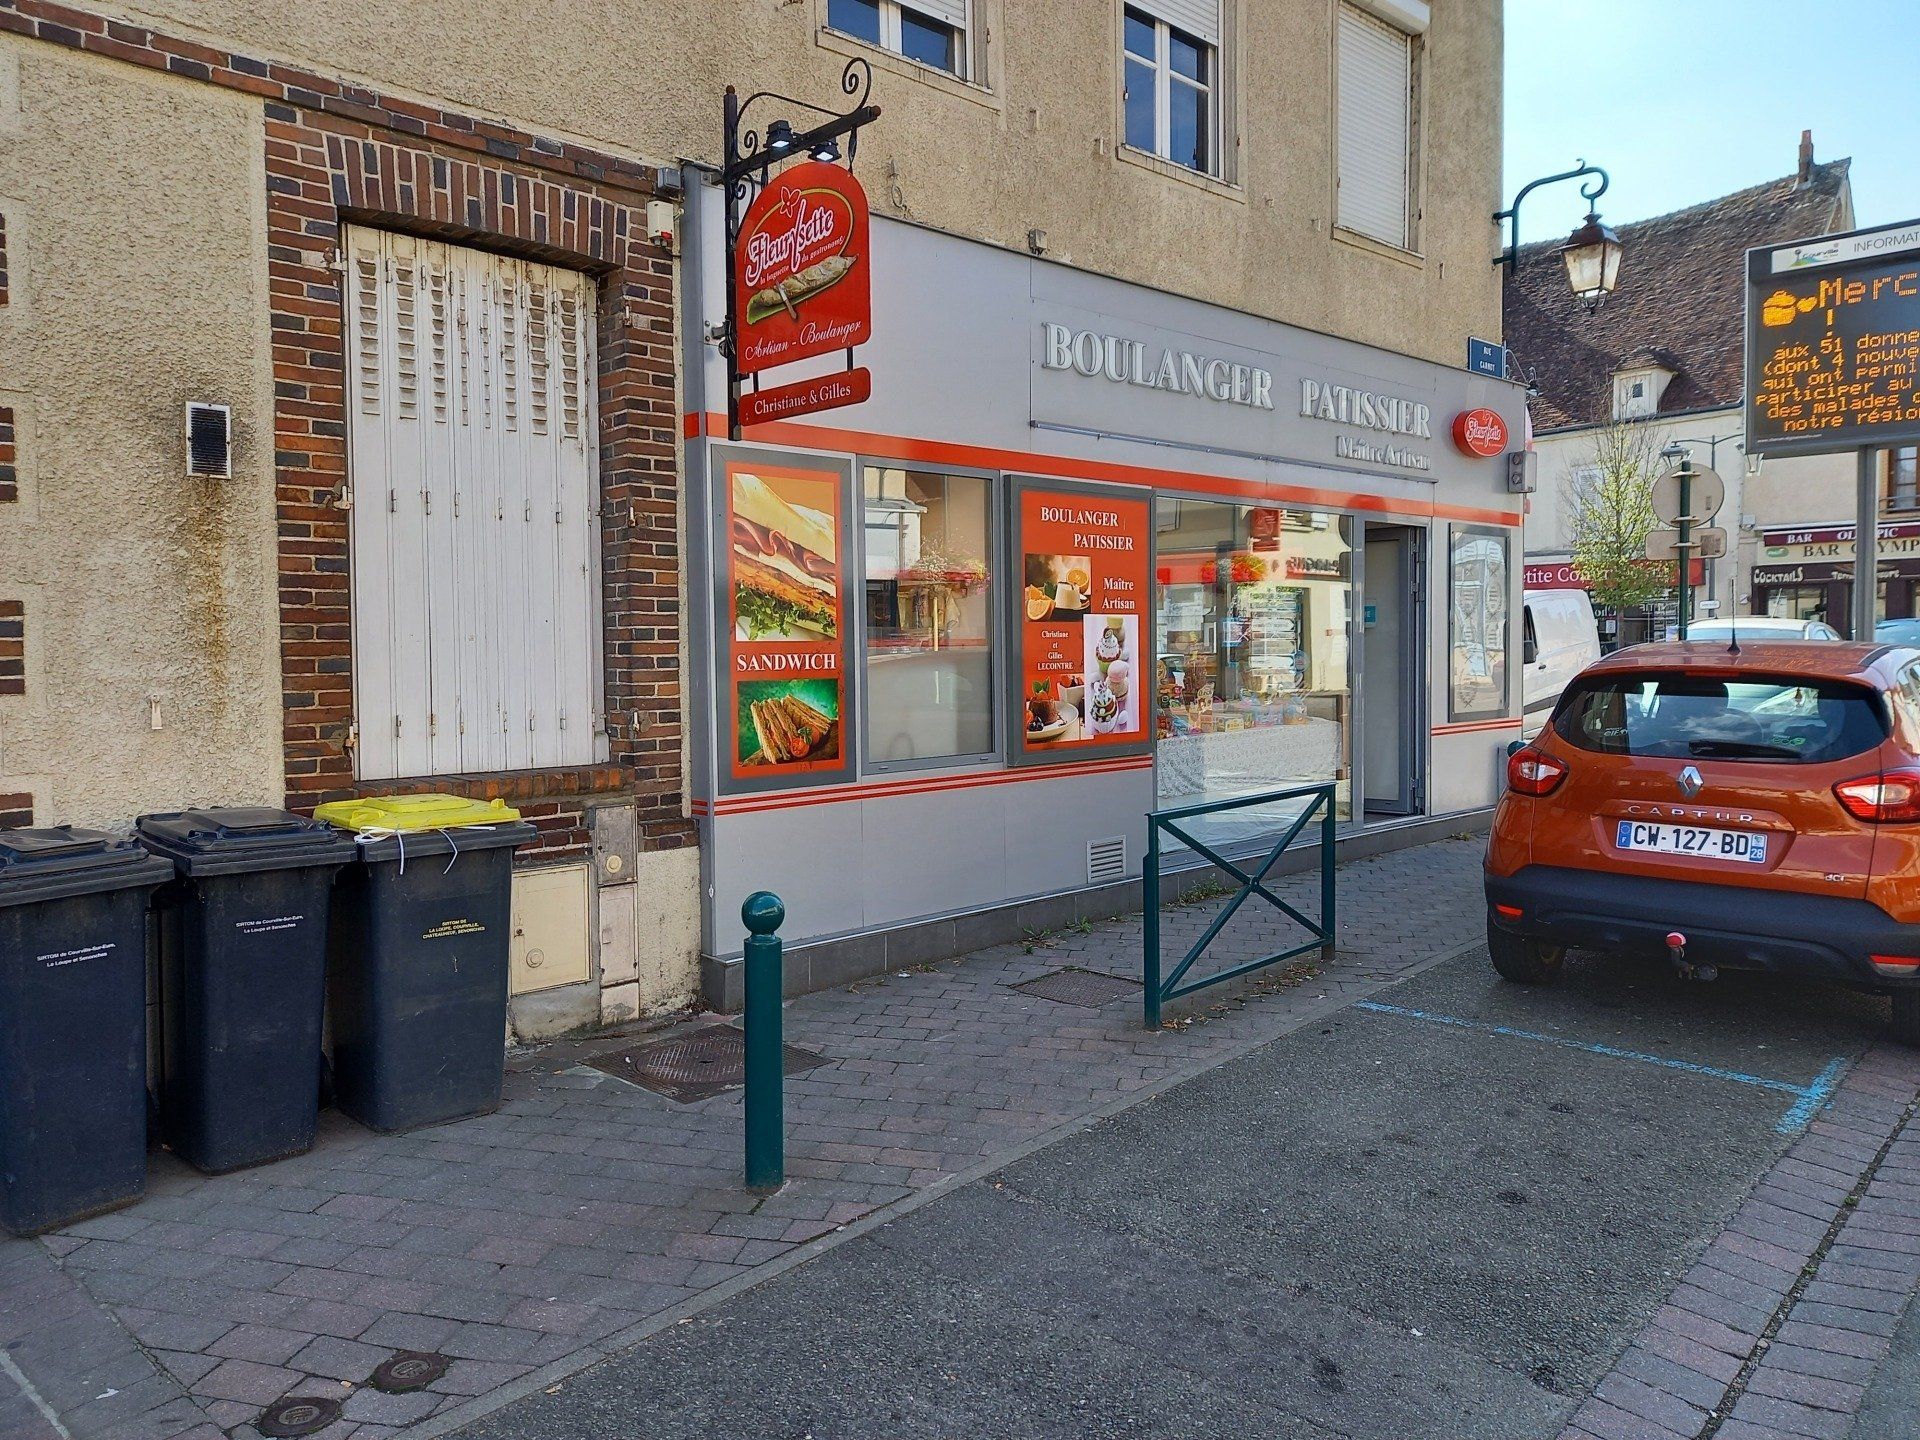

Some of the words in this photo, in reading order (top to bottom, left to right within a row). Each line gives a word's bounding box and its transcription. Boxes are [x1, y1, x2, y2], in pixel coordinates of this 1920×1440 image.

[1854, 231, 1920, 253] INFORMAT
[1819, 273, 1918, 308] Merc
[745, 337, 789, 361] Artisan
[800, 320, 862, 346] Boulanger
[1820, 337, 1842, 354] 51
[1856, 330, 1920, 349] donne
[1042, 322, 1275, 411] BOULANGER
[1832, 352, 1844, 367] 4
[1856, 346, 1920, 365] nouve
[1762, 374, 1795, 390] qui
[1808, 367, 1844, 386] ont
[1856, 359, 1917, 379] permi
[754, 395, 807, 415] Christiane
[809, 389, 818, 405] &
[819, 382, 852, 401] Gilles
[1755, 380, 1875, 406] participer
[1300, 377, 1432, 440] PATISSIER
[1767, 404, 1802, 419] des
[1813, 394, 1899, 414] malades
[1784, 414, 1844, 432] notre
[1857, 405, 1920, 425] régio
[1336, 435, 1384, 463] Maître
[1384, 443, 1432, 471] Artisan
[1040, 506, 1119, 527] BOULANGER
[1073, 533, 1134, 551] PATISSIER
[1787, 533, 1813, 544] BAR
[1837, 527, 1899, 541] OLPIC
[1803, 544, 1840, 557] BAR
[1103, 577, 1134, 591] Maître
[1753, 566, 1803, 584] COCKTAILS
[1102, 596, 1135, 610] Artisan
[1041, 630, 1069, 638] Christiane
[736, 653, 837, 672] SANDWICH
[1047, 651, 1063, 660] Gilles
[1037, 662, 1074, 671] LECOINTRE
[1628, 805, 1753, 822] CAPTUR
[1750, 849, 1763, 859] 28
